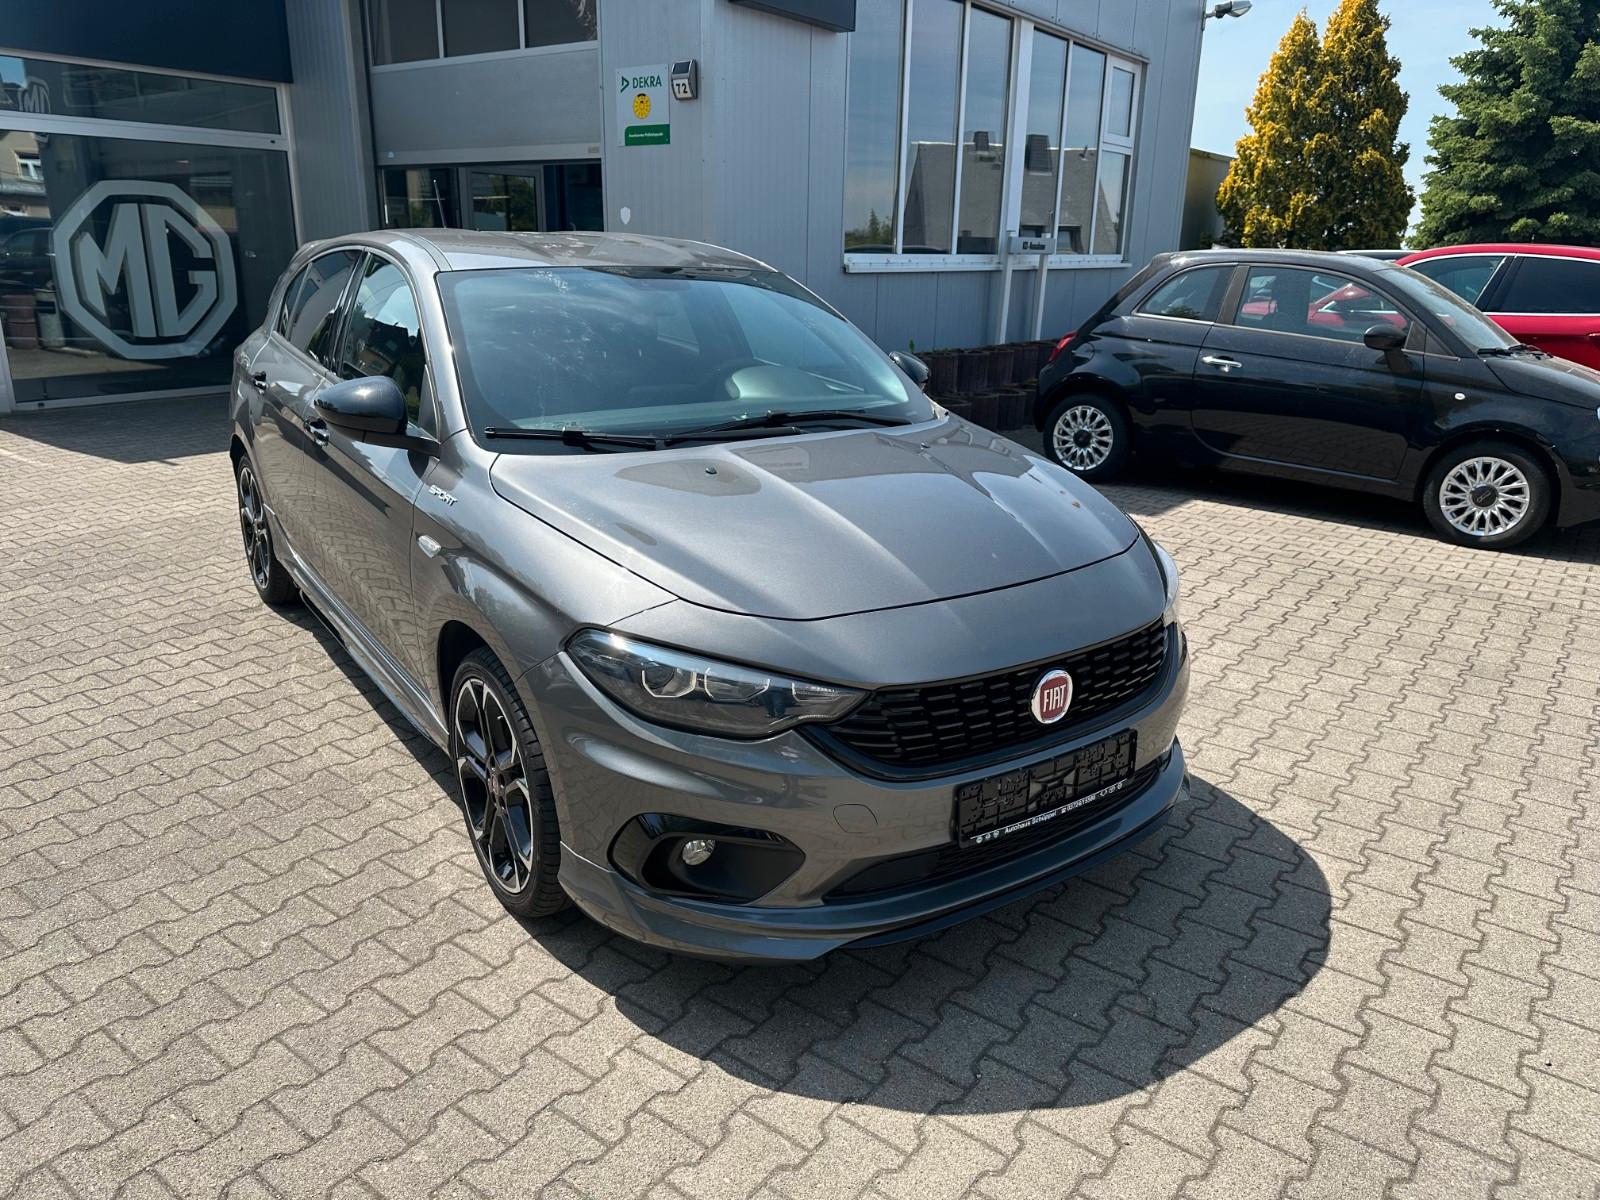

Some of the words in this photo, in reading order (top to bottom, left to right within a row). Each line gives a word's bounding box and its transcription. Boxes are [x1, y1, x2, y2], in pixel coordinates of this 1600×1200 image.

[632, 74, 662, 89] DEKRA
[78, 202, 217, 338] MG
[429, 484, 458, 506] SPORT
[1043, 684, 1067, 713] FIAT
[1004, 819, 1031, 834] Autohaus
